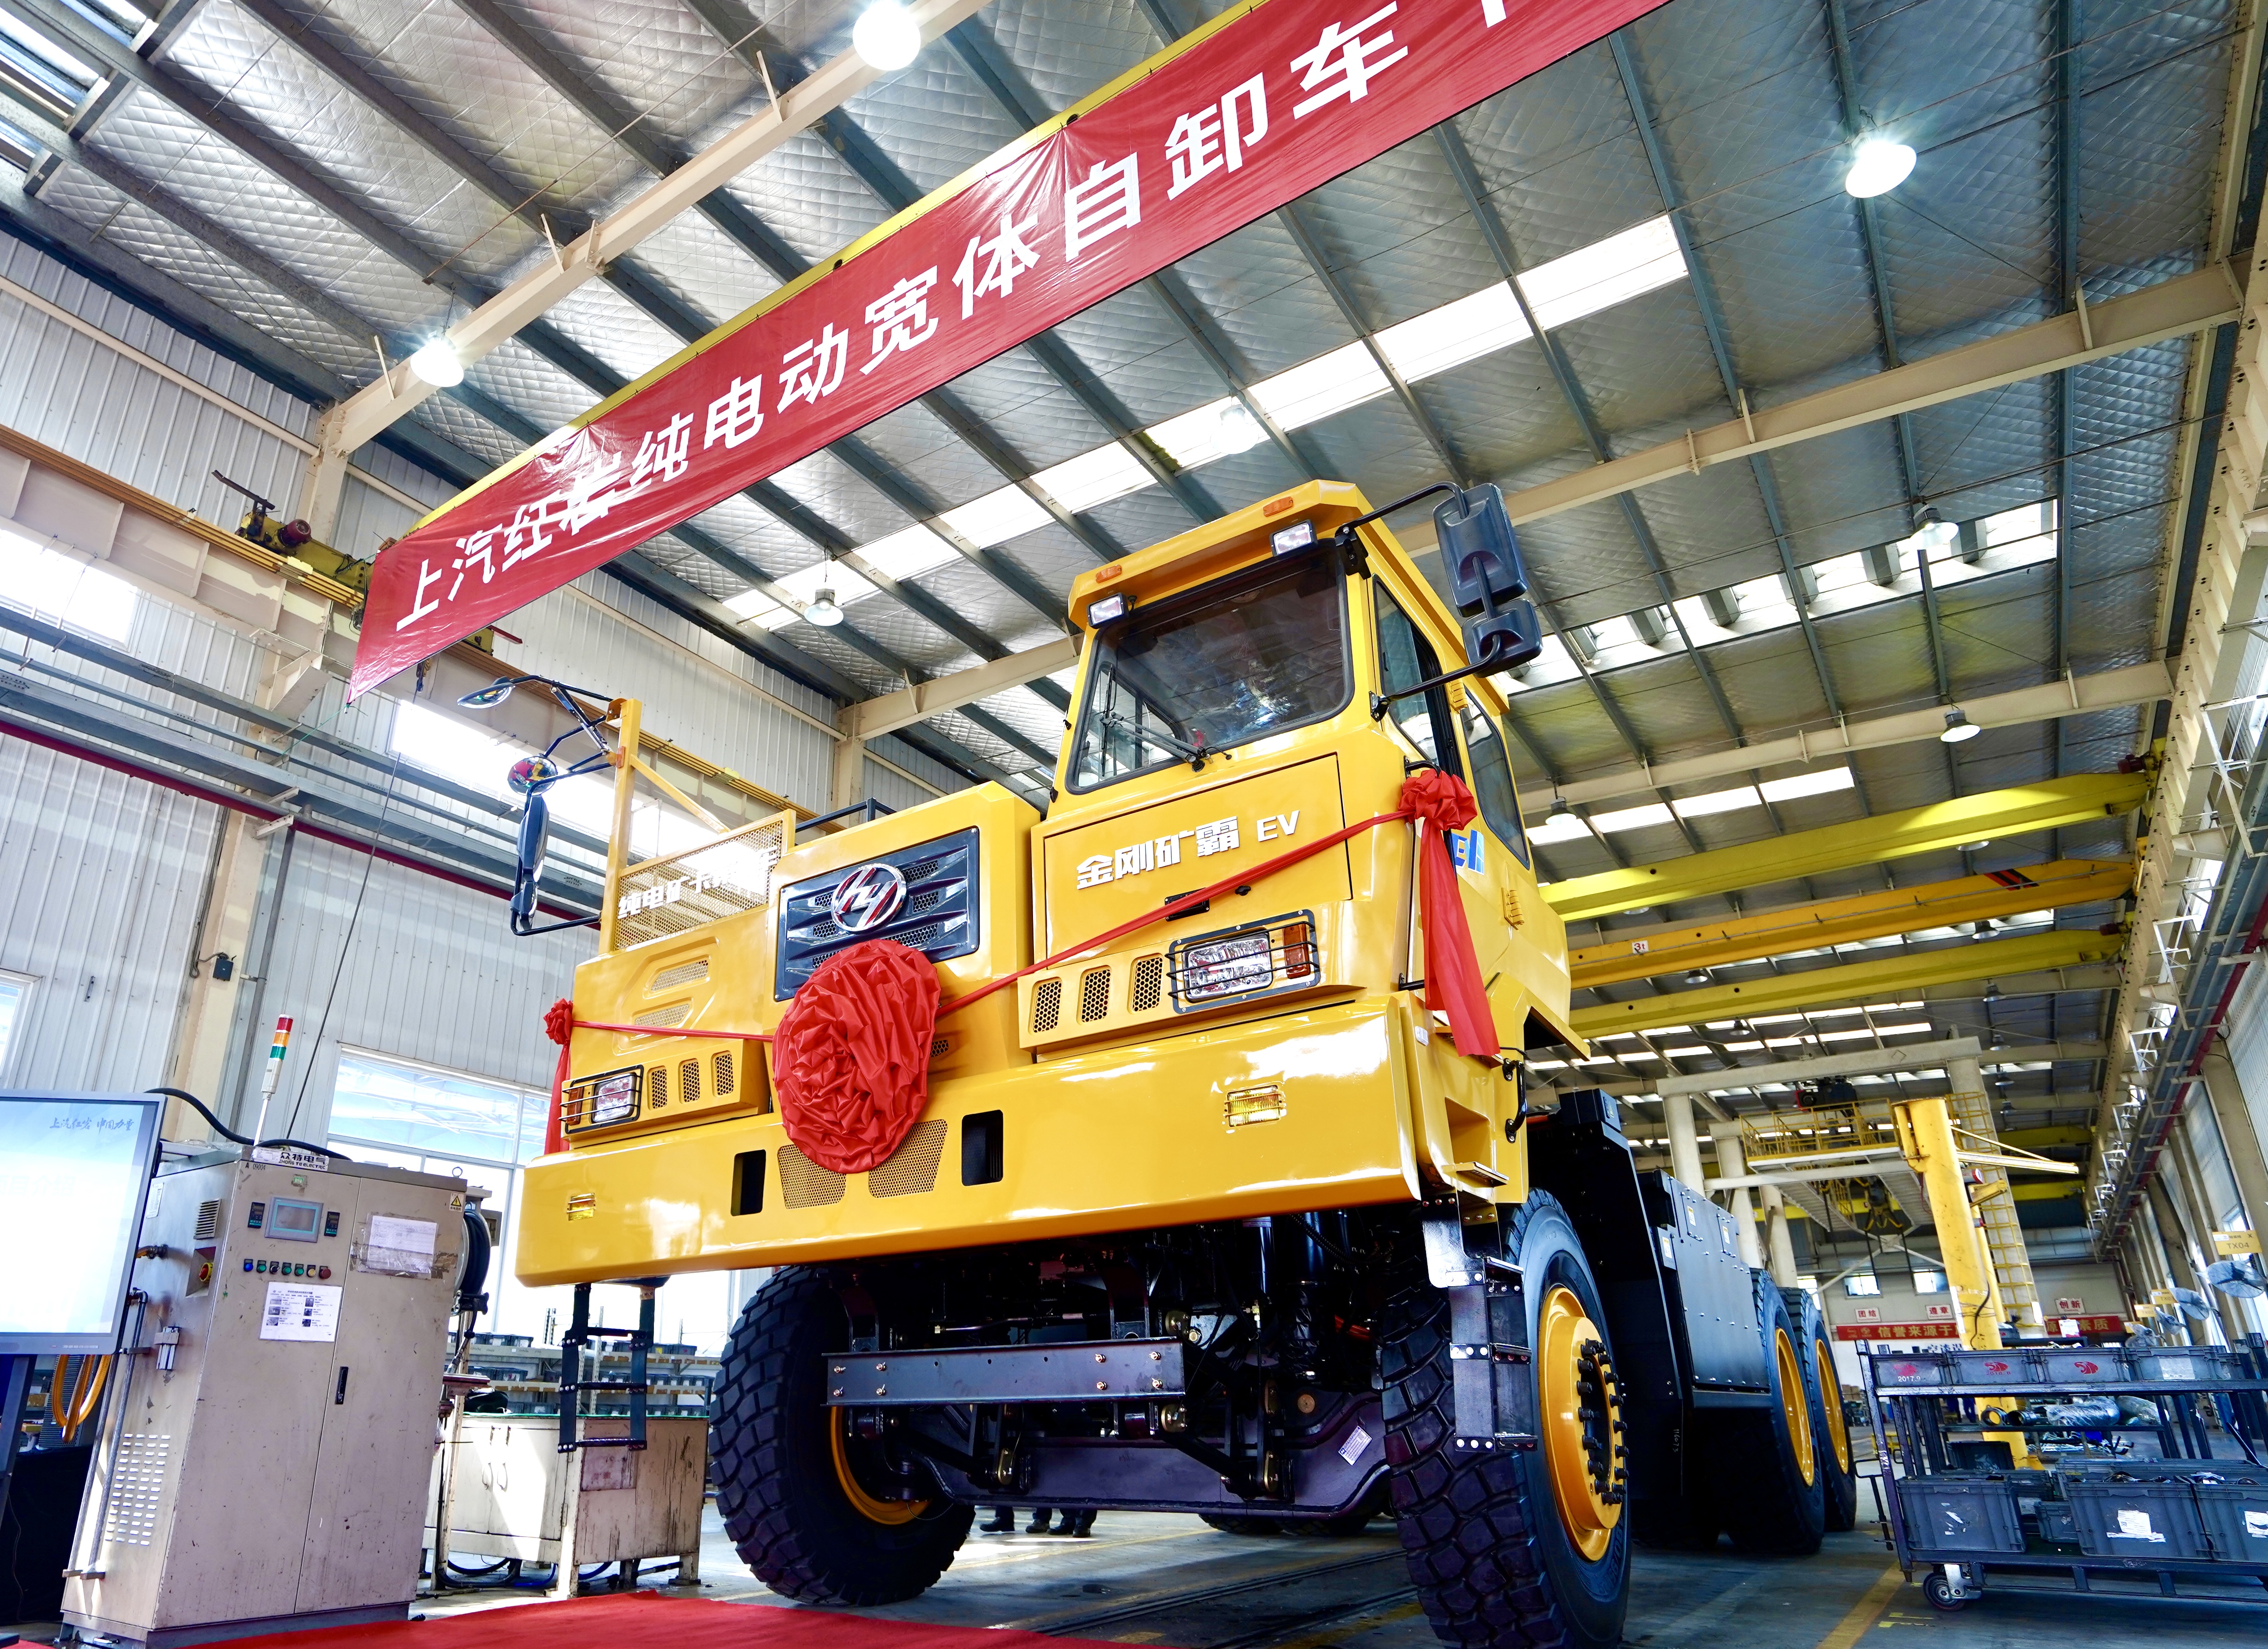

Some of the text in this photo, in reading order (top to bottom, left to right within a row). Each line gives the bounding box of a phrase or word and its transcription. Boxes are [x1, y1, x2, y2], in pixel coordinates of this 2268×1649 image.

[1075, 810, 1300, 890] 金刚矿霸 EV
[49, 1117, 92, 1131] 上汽红岩
[280, 1152, 326, 1165] 众特电气
[2059, 1300, 2081, 1309] 创新
[1858, 1309, 1876, 1318] 团结
[1878, 1325, 1959, 1338] 信誉来源于
